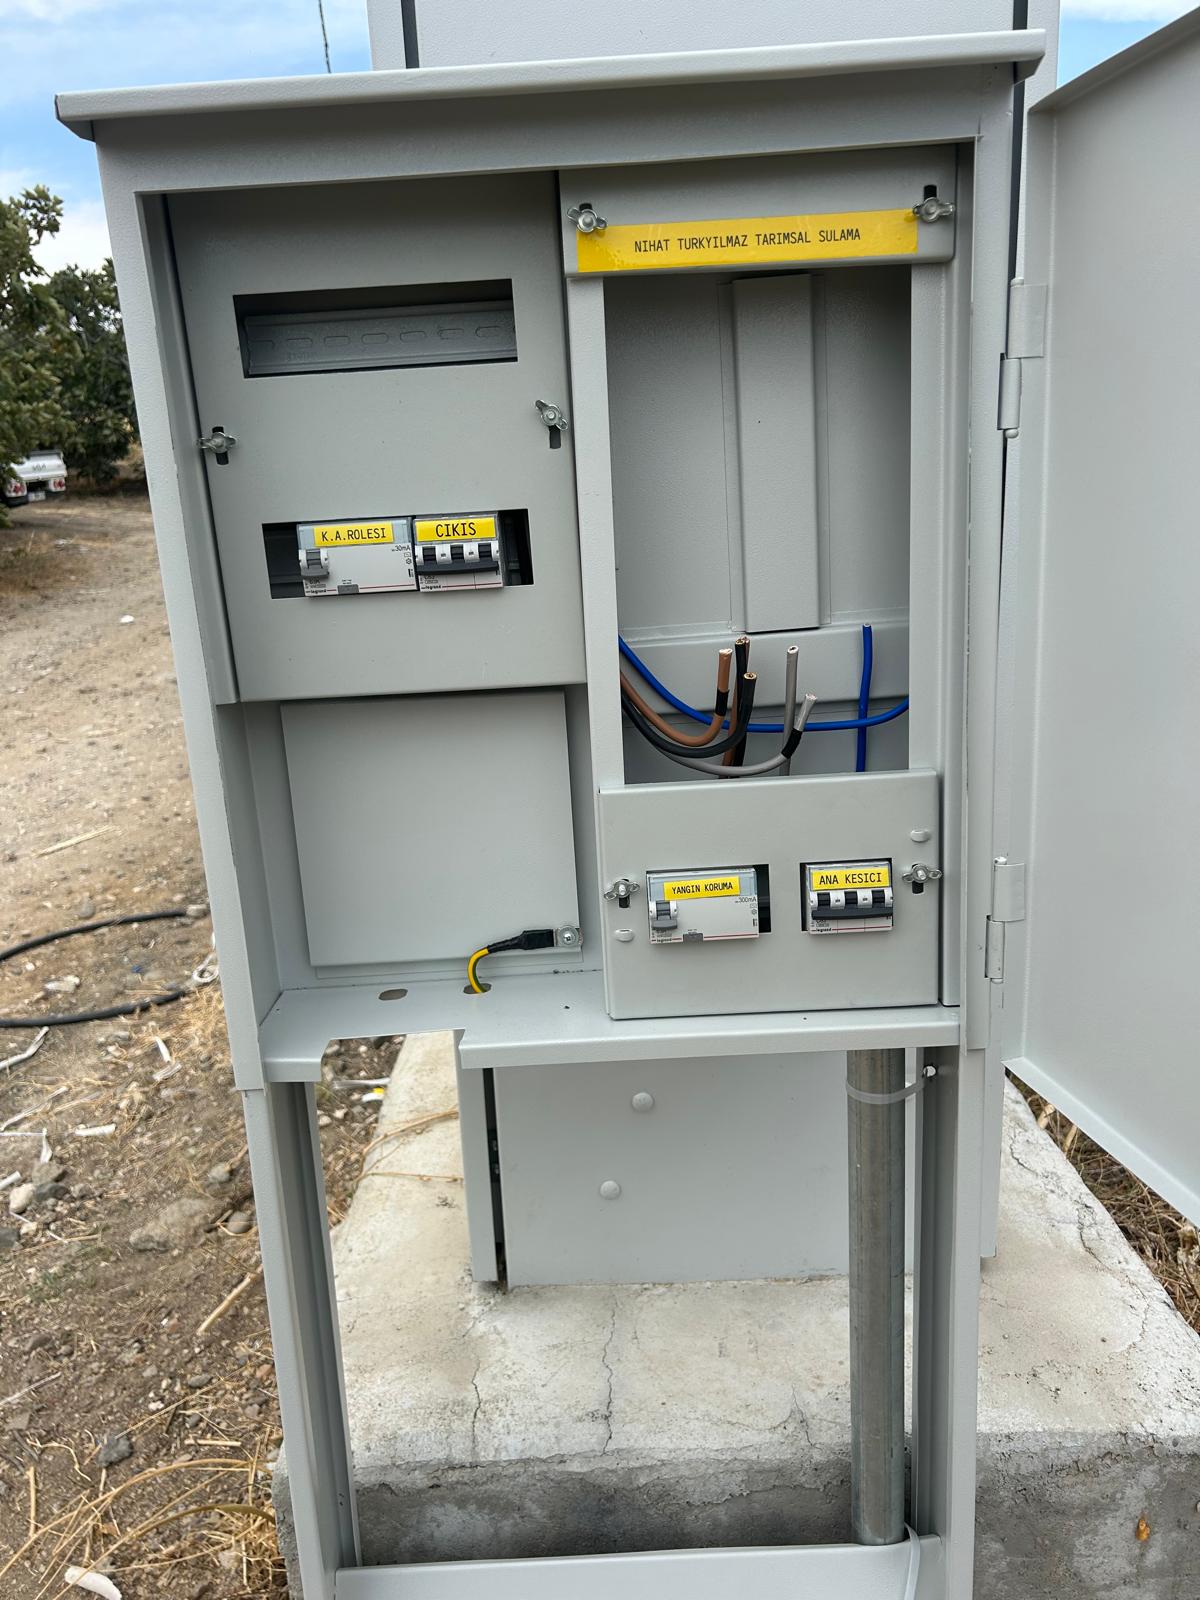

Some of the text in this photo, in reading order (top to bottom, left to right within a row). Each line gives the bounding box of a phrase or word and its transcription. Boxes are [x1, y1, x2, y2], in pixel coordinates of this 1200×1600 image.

[634, 228, 861, 253] NIHAT TURKYILMAZ TARIMSAL SULAMA
[321, 527, 387, 542] K.A.ROLESI
[435, 522, 477, 537] CIKIS
[819, 872, 882, 885] ANA KESICI
[671, 881, 733, 895] YANGIN KORUMA
